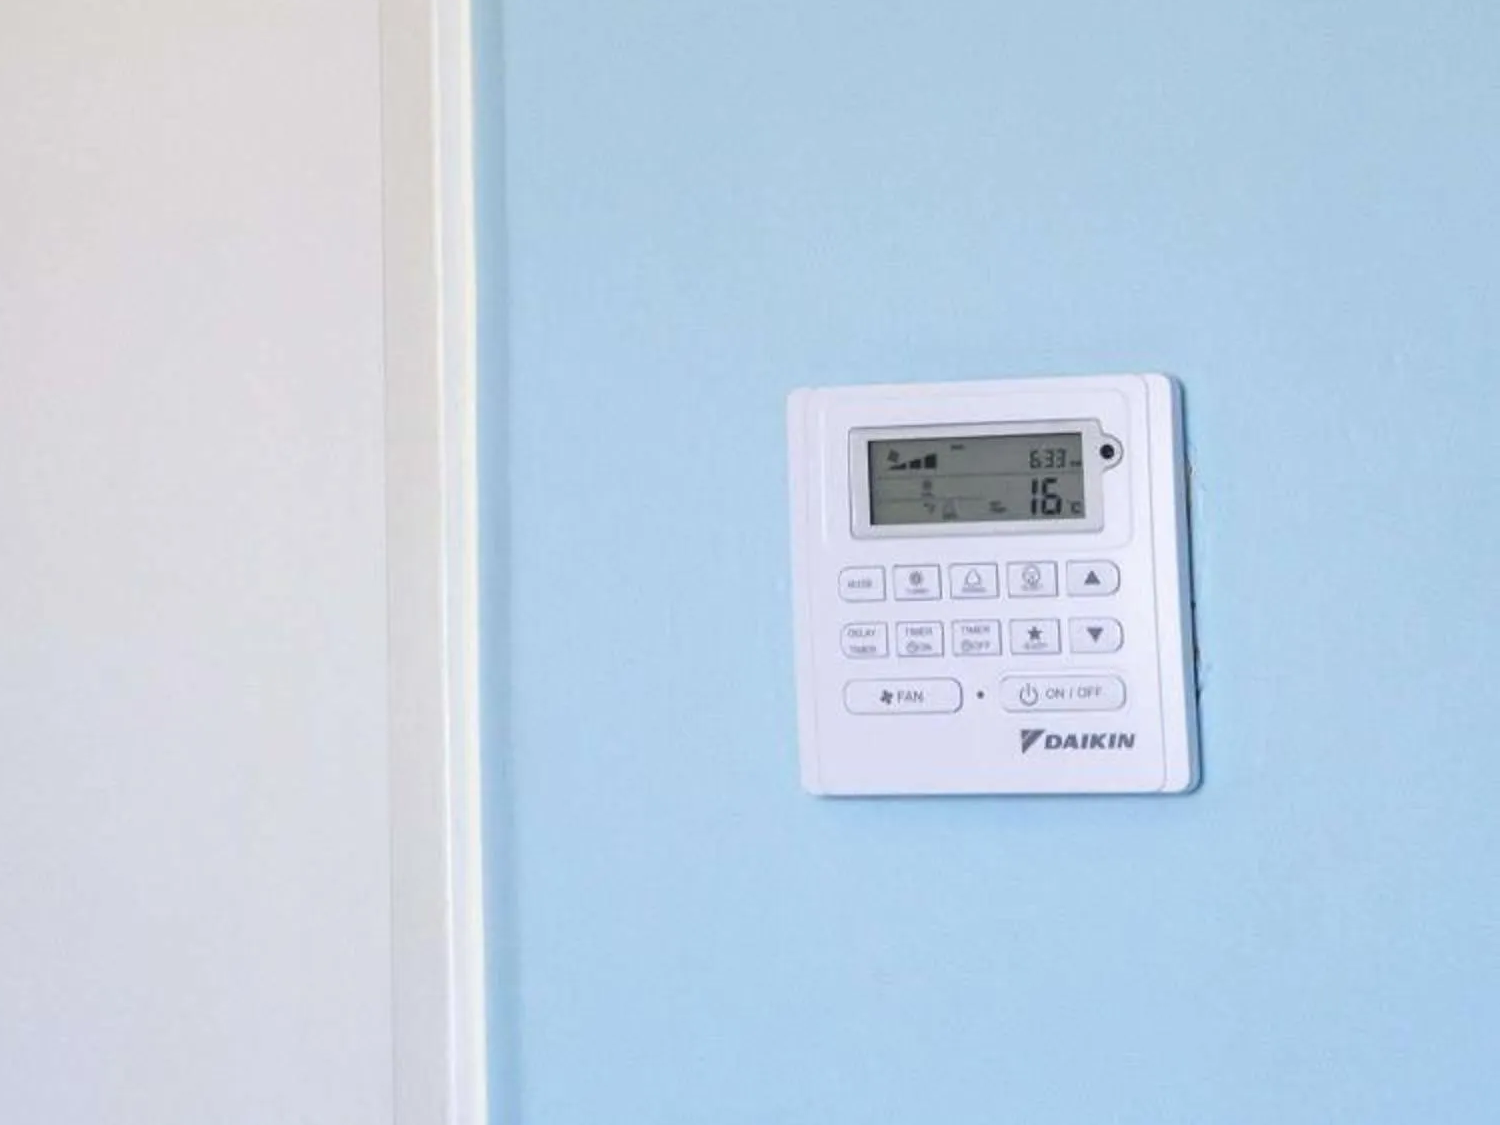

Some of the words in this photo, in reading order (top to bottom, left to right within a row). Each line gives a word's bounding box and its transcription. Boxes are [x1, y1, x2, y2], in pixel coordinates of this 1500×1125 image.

[1030, 477, 1063, 515] 16
[896, 689, 925, 704] FAN
[1043, 732, 1135, 751] DAIKIN
